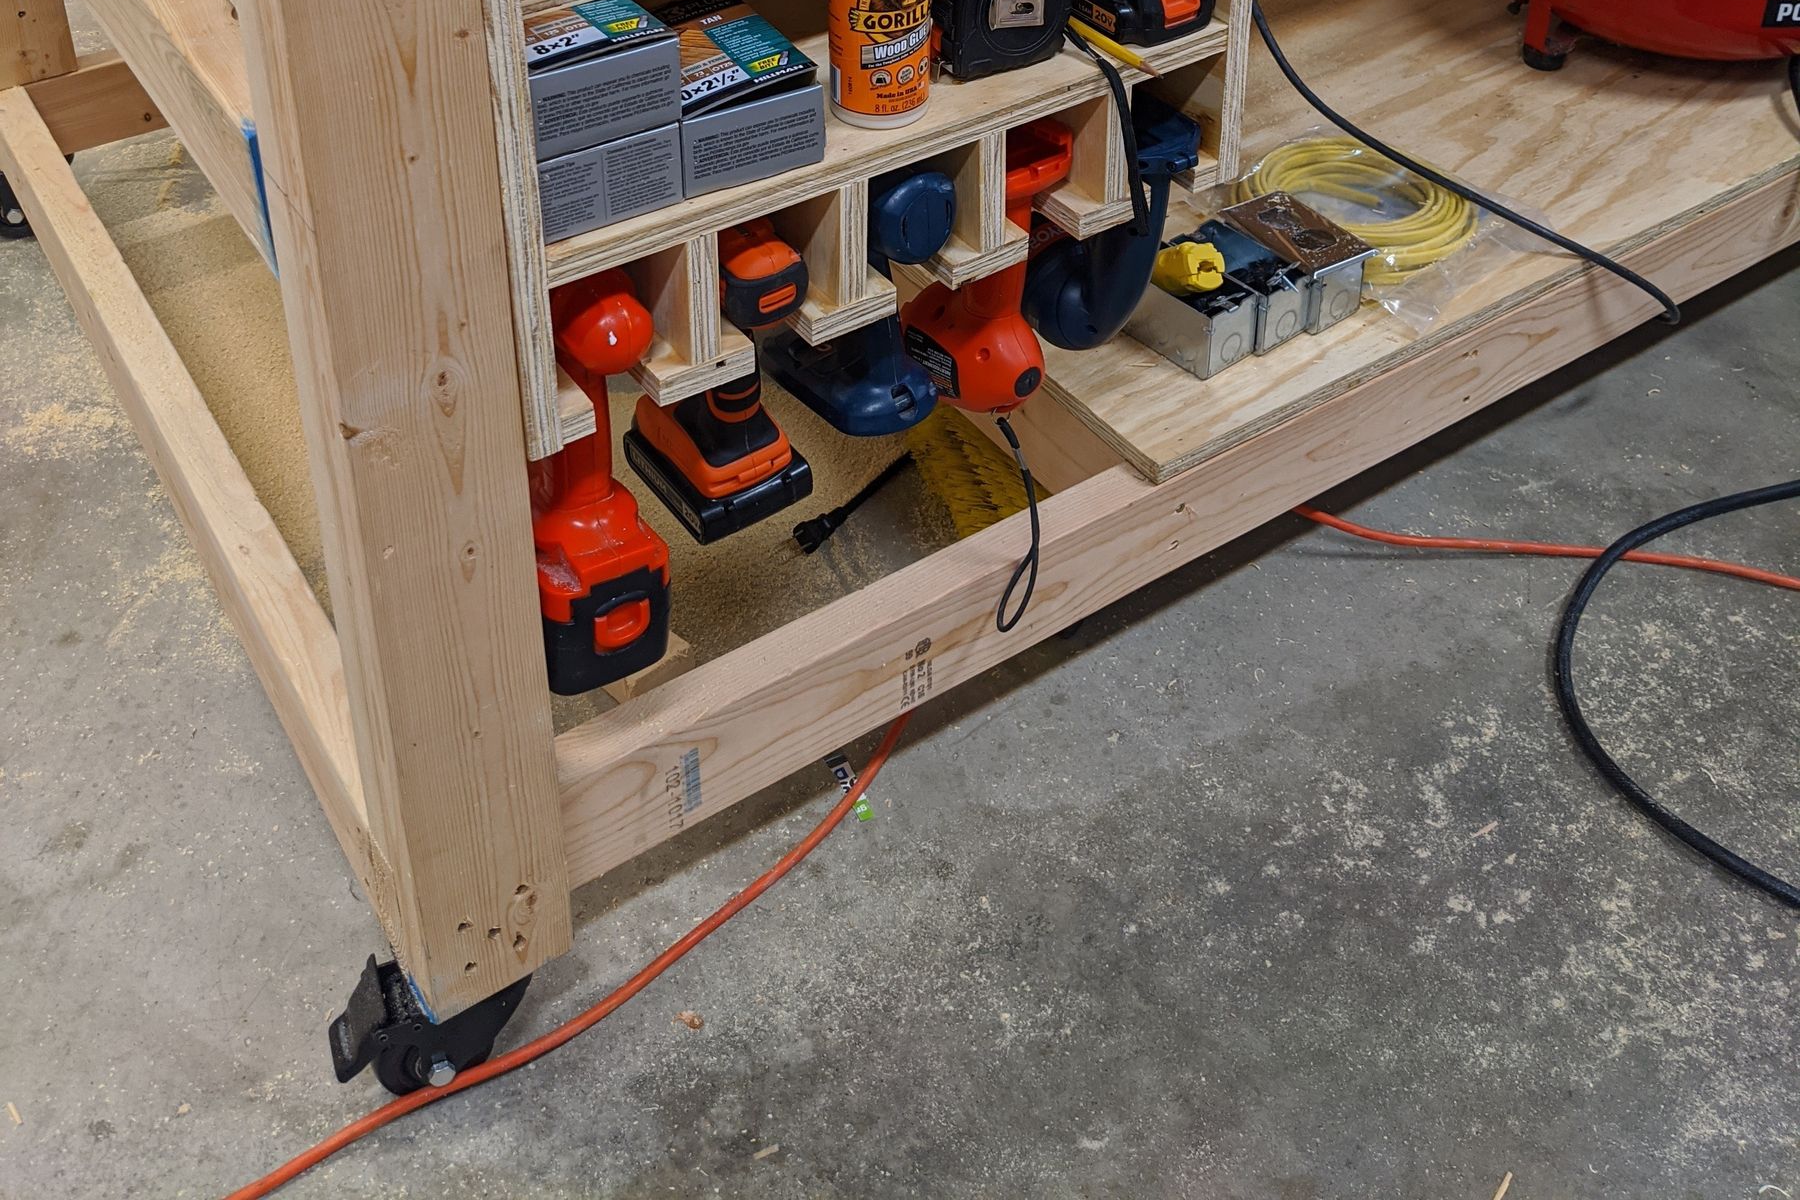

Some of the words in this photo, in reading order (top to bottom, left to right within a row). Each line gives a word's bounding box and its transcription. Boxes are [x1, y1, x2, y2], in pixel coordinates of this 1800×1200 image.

[700, 14, 723, 26] TAN
[863, 4, 928, 30] GORILL
[610, 27, 666, 44] HILLMAN
[753, 64, 804, 84] HILLMAN
[905, 86, 917, 95] USA
[665, 765, 684, 830] 102-1017
